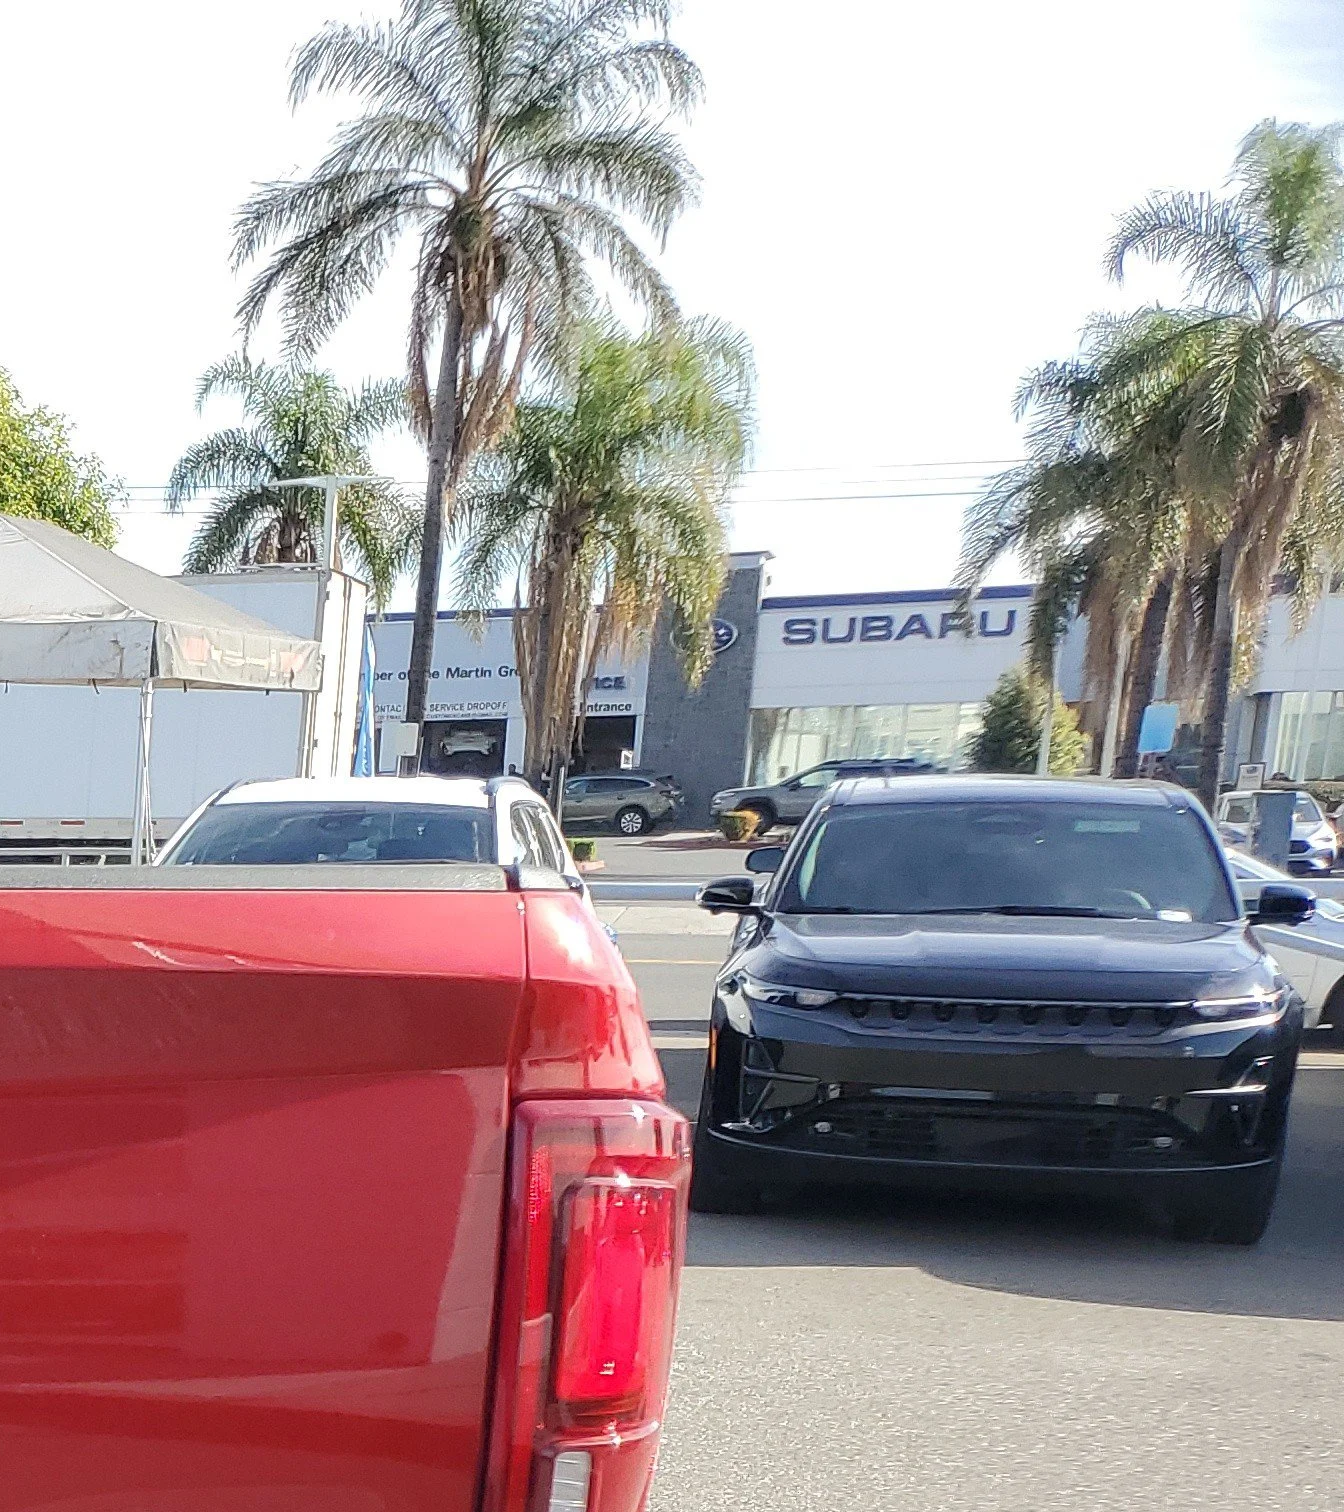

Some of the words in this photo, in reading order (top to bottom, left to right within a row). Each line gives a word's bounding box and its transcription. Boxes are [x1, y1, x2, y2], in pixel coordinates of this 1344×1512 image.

[782, 609, 1017, 644] SUBARU
[446, 667, 492, 679] Martin
[430, 703, 464, 712] SERVICE
